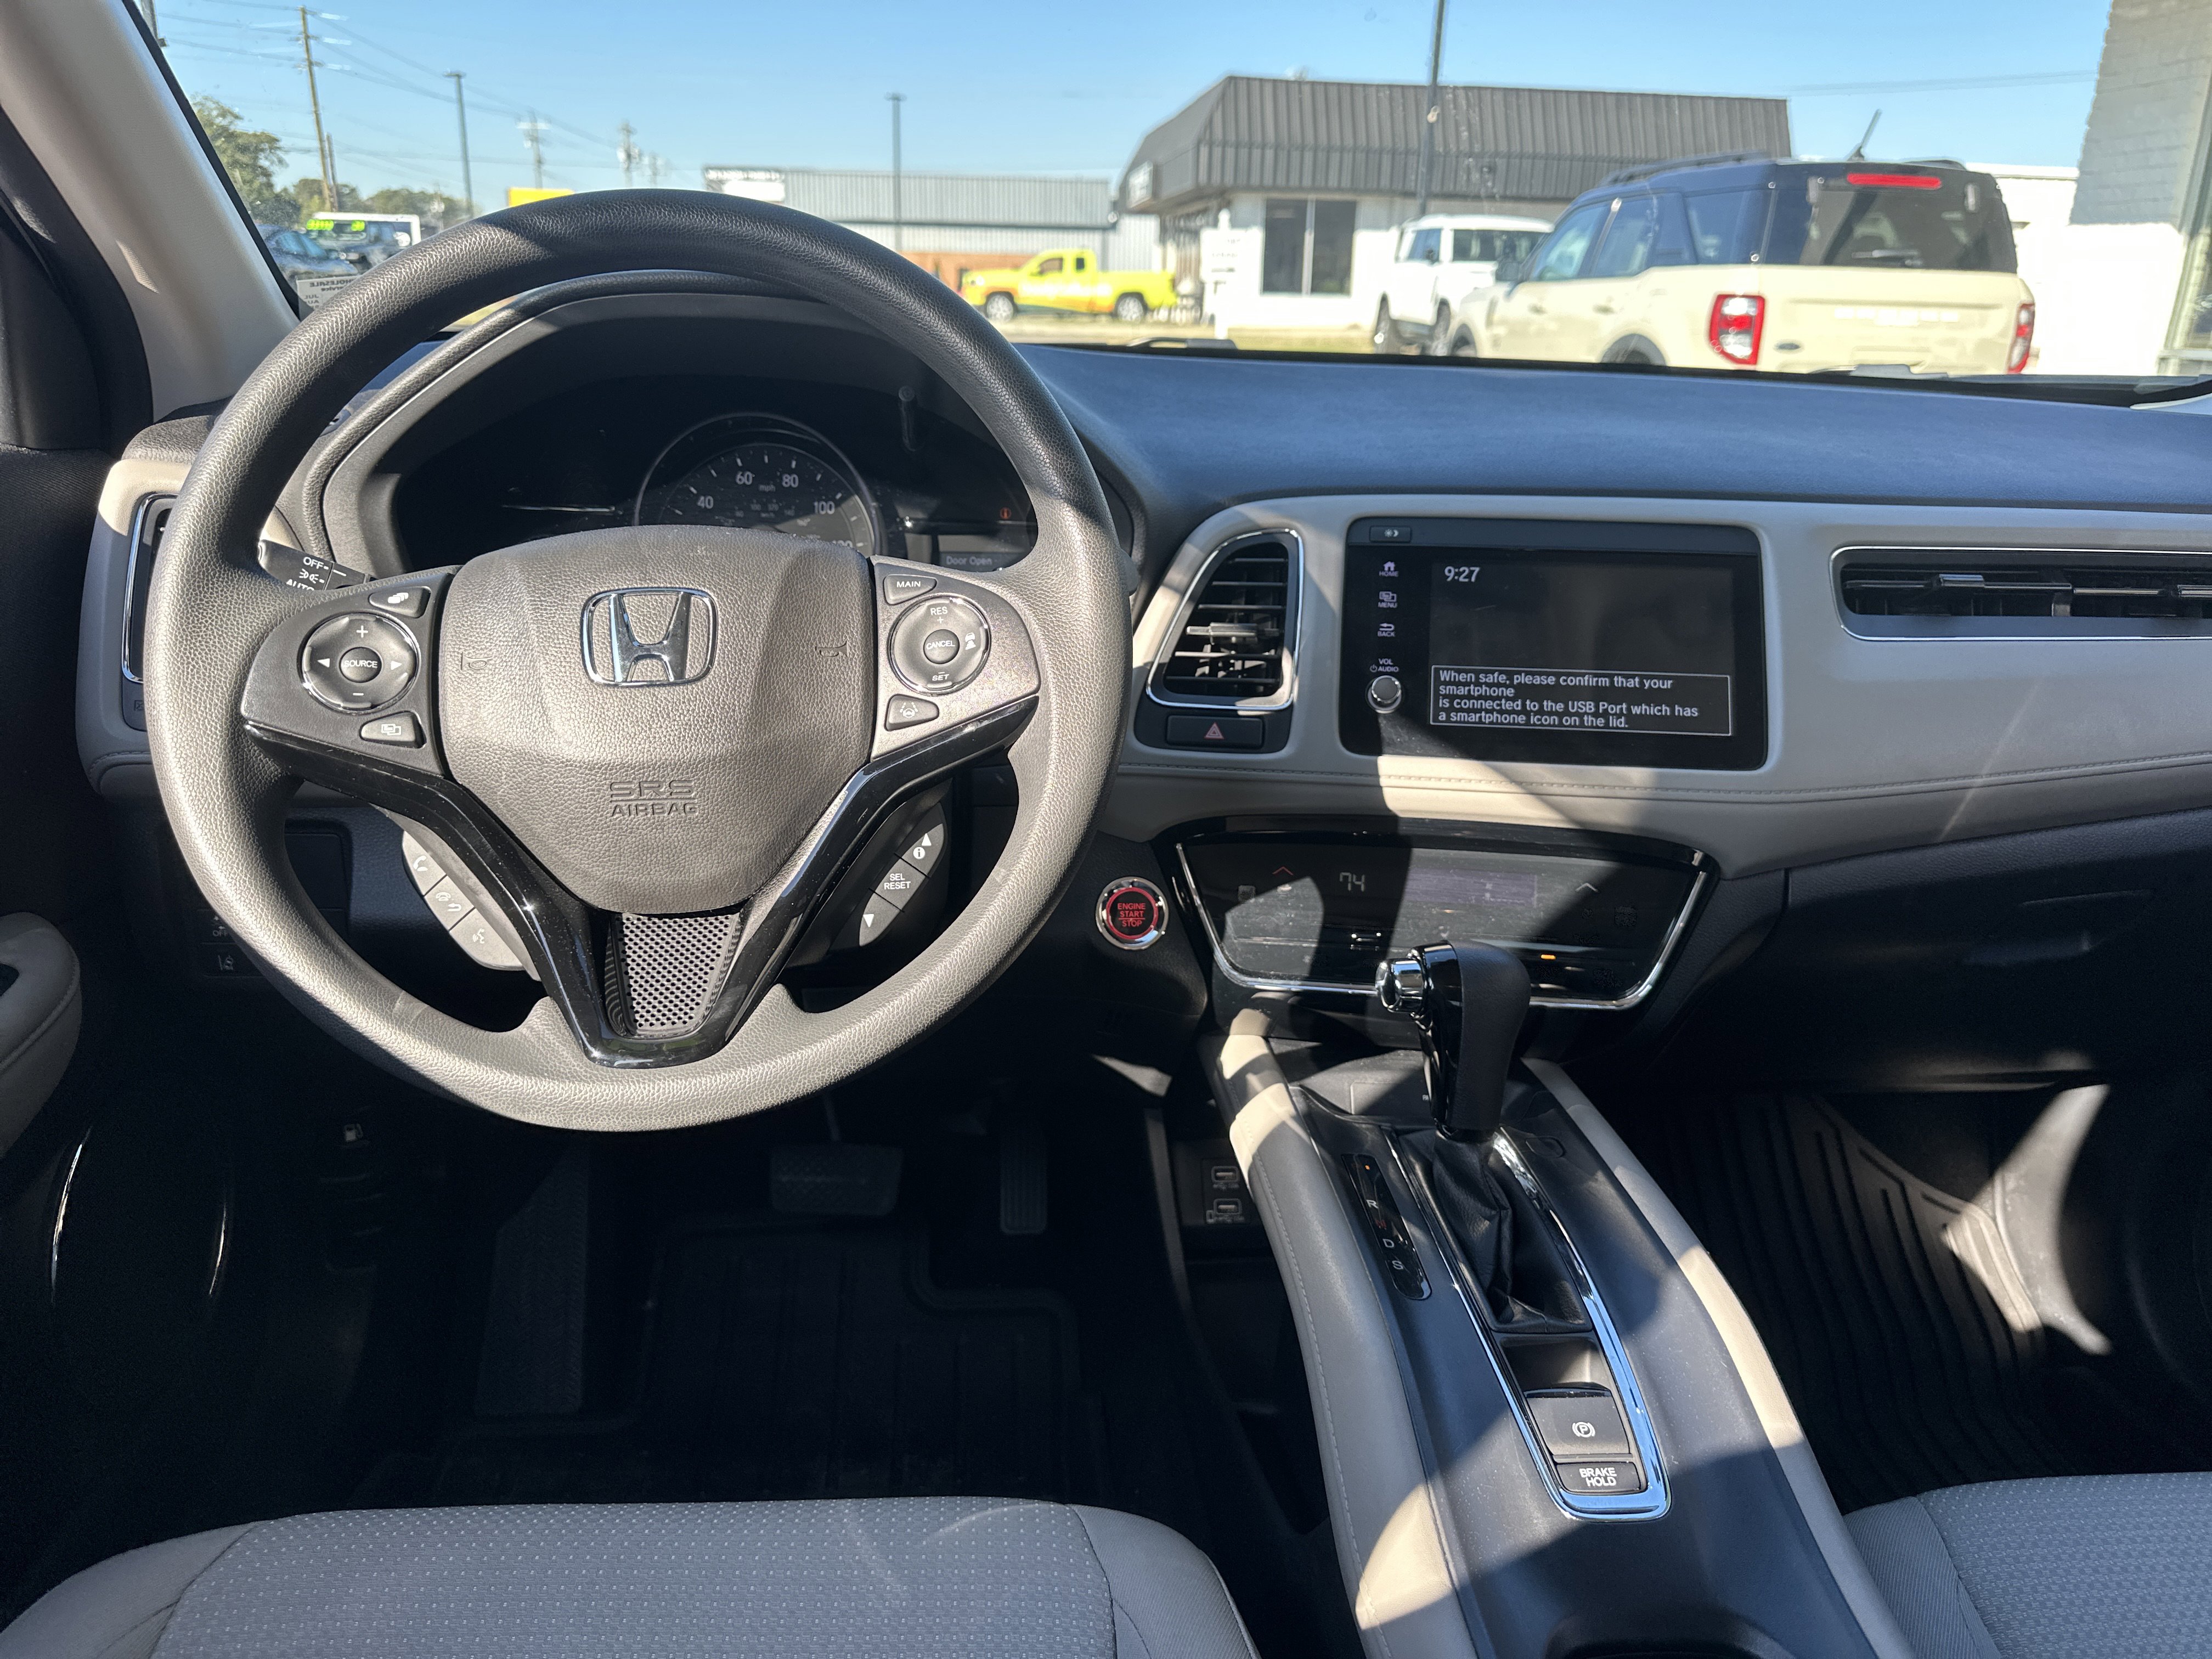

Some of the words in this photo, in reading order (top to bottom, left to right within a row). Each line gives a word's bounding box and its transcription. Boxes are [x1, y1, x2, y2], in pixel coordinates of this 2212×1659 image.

[736, 472, 753, 485] 60
[782, 474, 799, 488] 80
[759, 484, 776, 493] mph
[697, 496, 714, 509] 40
[814, 501, 835, 515] 100
[303, 556, 324, 569] OFF
[946, 556, 967, 565] Door
[969, 556, 992, 566] Open
[1444, 566, 1480, 582] 9:27
[930, 606, 948, 616] RES
[926, 640, 955, 650] CANCEL
[344, 660, 377, 668] SOURCE
[1440, 670, 1475, 682] When
[1479, 672, 1510, 685] safe,
[1514, 673, 1555, 686] please
[1560, 674, 1609, 687] confirm
[1614, 676, 1639, 688] that
[1644, 679, 1673, 690] your
[1439, 685, 1515, 697] smartphone
[1439, 697, 1449, 708] is
[1453, 698, 1521, 710] connected
[1526, 699, 1539, 711] to
[1543, 700, 1564, 712] the
[1568, 701, 1595, 713] USB
[1599, 702, 1627, 714] Port
[1631, 703, 1670, 716] which
[1675, 705, 1699, 717] has
[1438, 712, 1446, 721] a
[1450, 711, 1526, 724] smartphone
[1530, 714, 1558, 725] icon
[1562, 716, 1579, 726] on
[1583, 715, 1605, 727] the
[1609, 716, 1628, 728] lid.
[610, 780, 695, 798] SRS
[611, 803, 698, 817] AIRBAG
[884, 881, 911, 890] RESET
[1339, 872, 1365, 892] 74
[1366, 1199, 1379, 1209] R
[1383, 1239, 1395, 1248] D
[1392, 1260, 1404, 1270] S
[1579, 1467, 1617, 1478] BRAKE
[1585, 1476, 1617, 1487] HOLD
